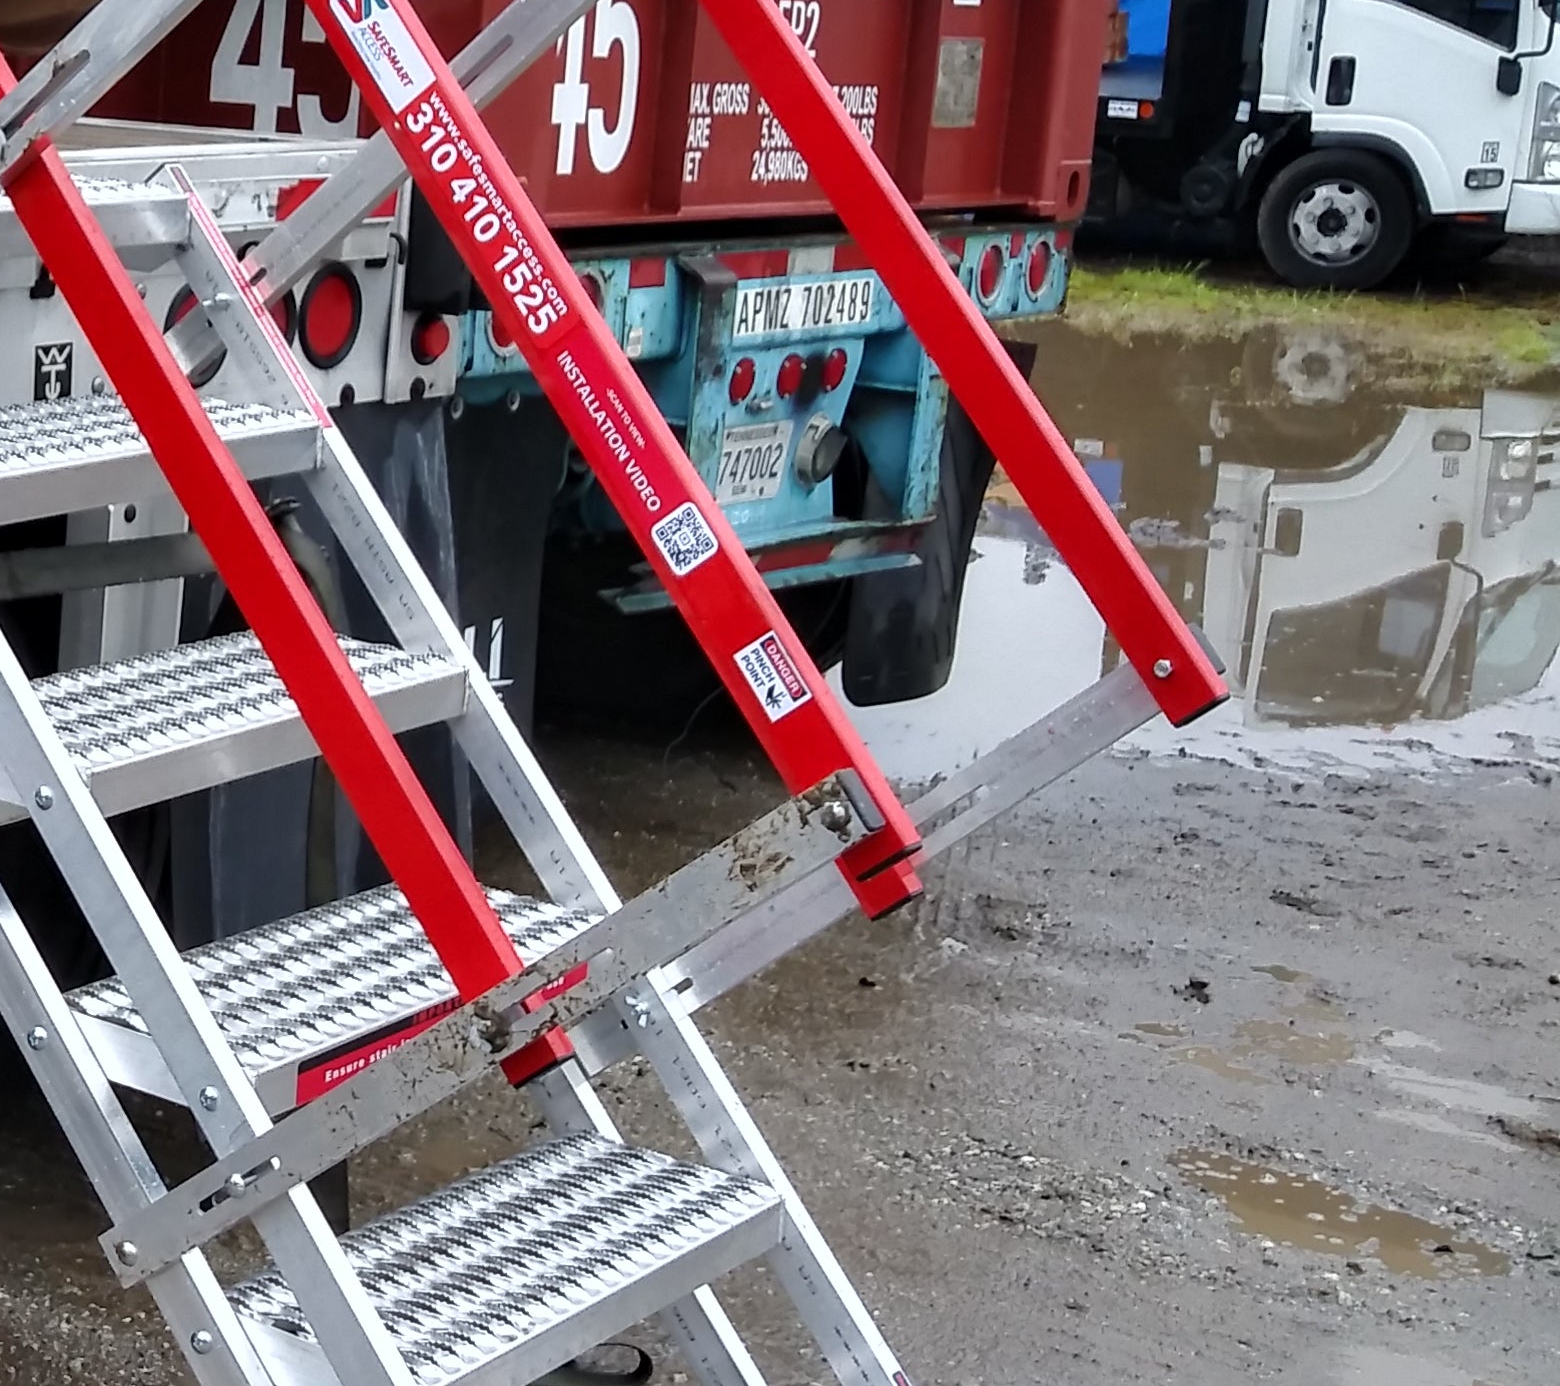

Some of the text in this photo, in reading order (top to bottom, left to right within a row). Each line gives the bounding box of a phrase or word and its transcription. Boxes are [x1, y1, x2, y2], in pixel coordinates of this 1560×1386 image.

[357, 27, 384, 62] ACCESS
[367, 20, 414, 88] SAFESMART
[713, 83, 750, 115] GROSS
[687, 117, 711, 148] ARE
[683, 151, 702, 182] ET
[406, 102, 558, 334] 310 410 1525
[429, 91, 568, 317] www.safesmartaccess.com
[737, 280, 871, 334] APMZ 702489
[557, 350, 661, 512] INSTALLATION VIDEO
[719, 442, 784, 485] 747002
[741, 655, 766, 688] POINT
[750, 648, 775, 683] PINCH
[767, 643, 800, 693] DANGER
[324, 1058, 365, 1083] Ensure
